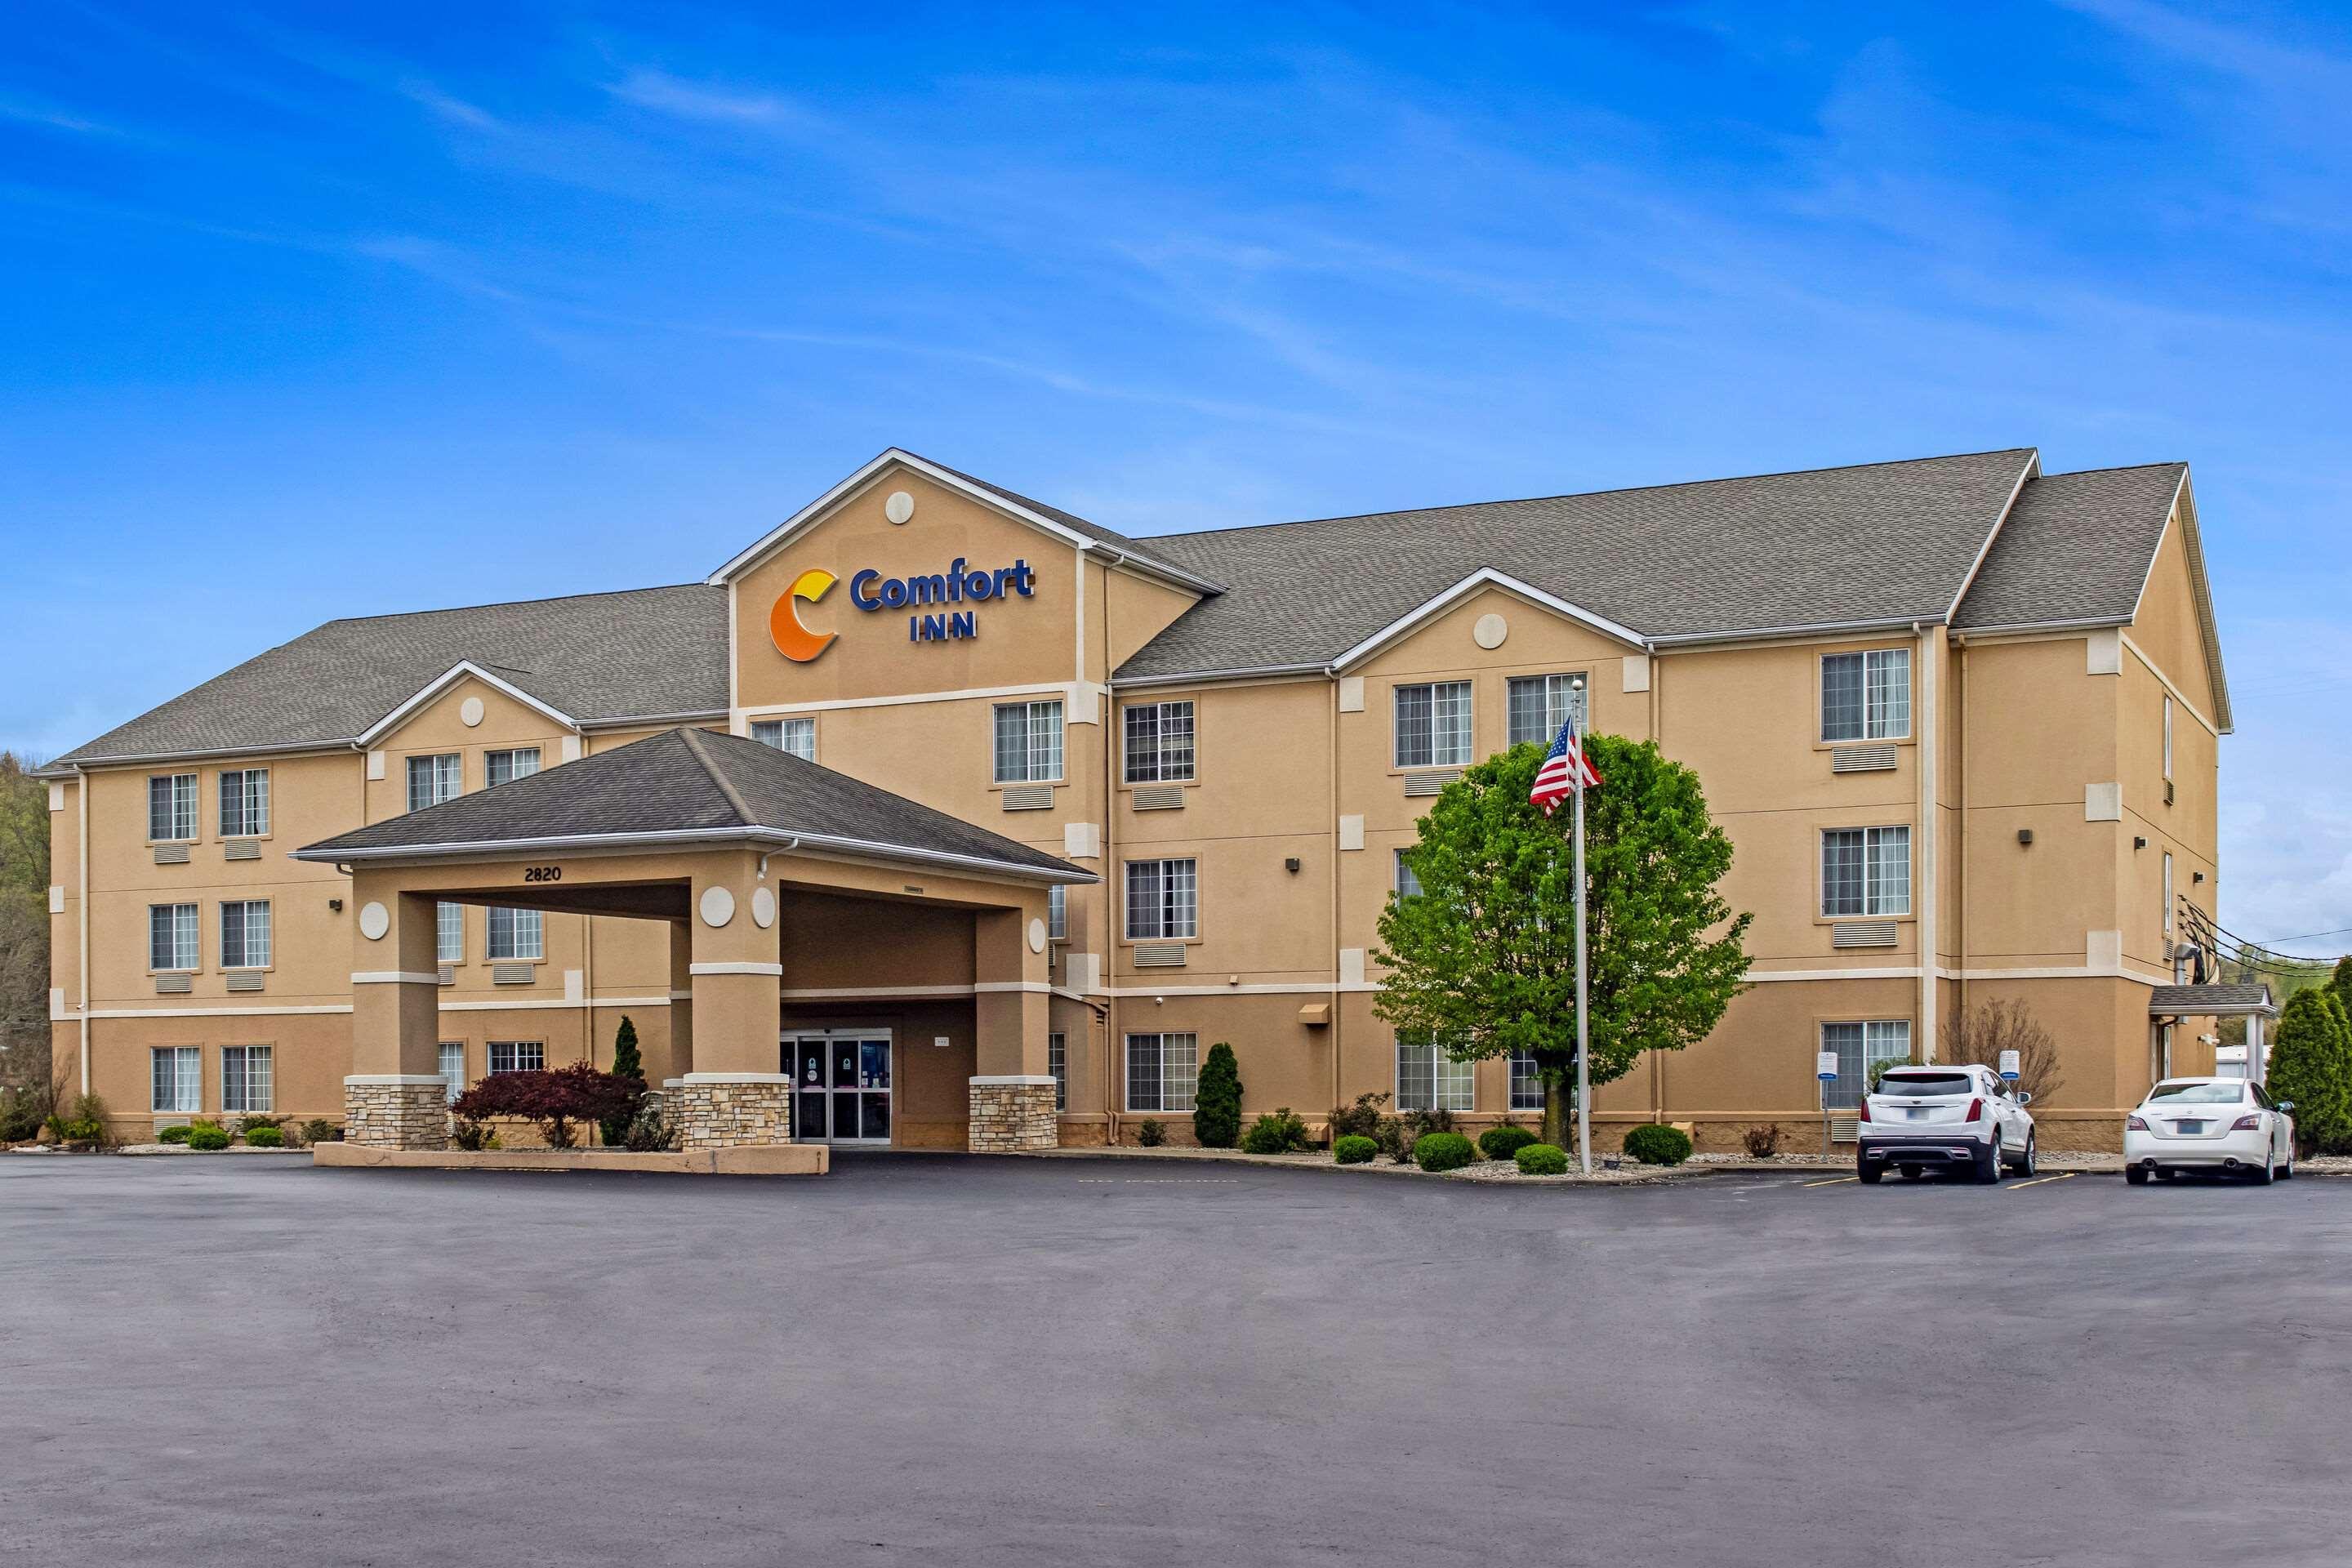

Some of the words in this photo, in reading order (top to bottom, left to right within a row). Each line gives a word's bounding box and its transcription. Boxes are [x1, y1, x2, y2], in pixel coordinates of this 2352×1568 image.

[849, 557, 1035, 611] Comfort
[910, 611, 977, 642] INN
[525, 866, 561, 882] 2820
